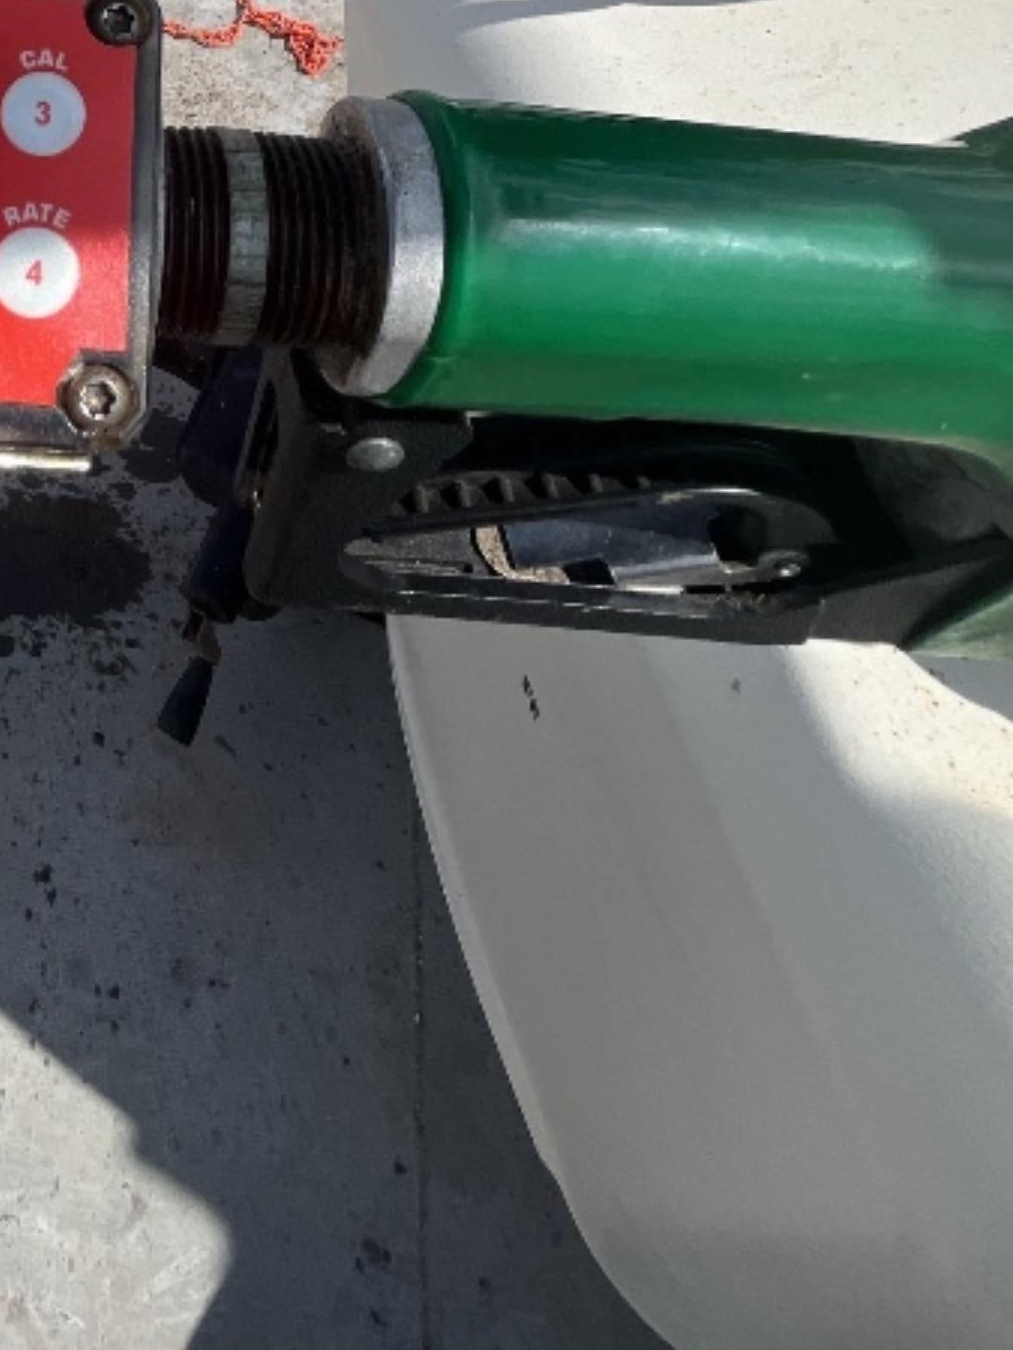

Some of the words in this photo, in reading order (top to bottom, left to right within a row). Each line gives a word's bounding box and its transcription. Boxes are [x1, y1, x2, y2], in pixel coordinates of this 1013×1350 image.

[19, 49, 69, 71] CAL
[34, 101, 52, 126] 3
[2, 203, 71, 228] RATE
[25, 260, 44, 286] 4
